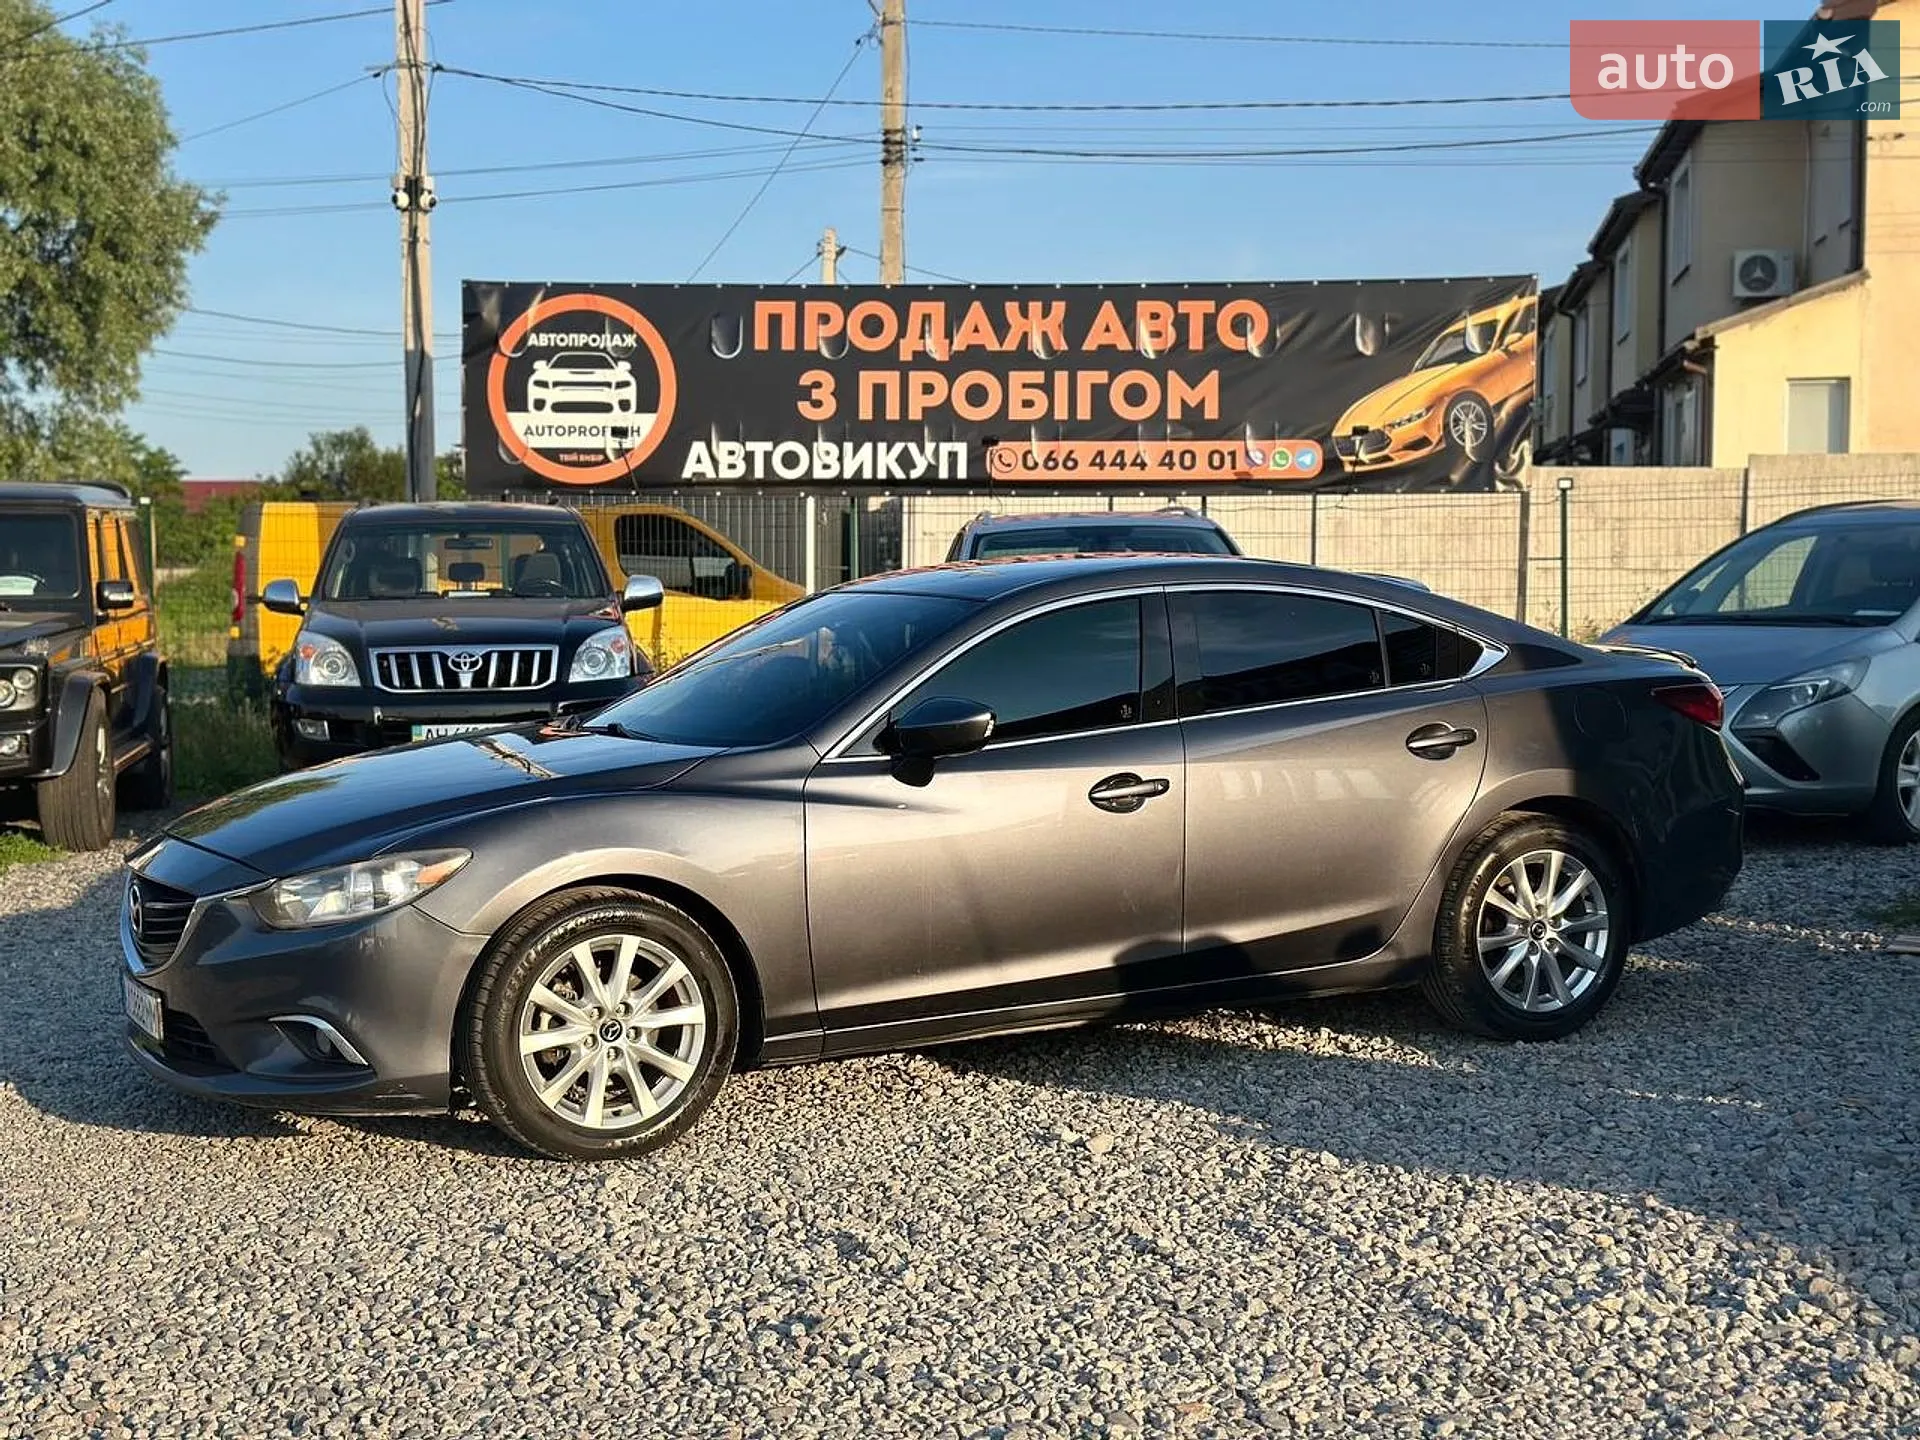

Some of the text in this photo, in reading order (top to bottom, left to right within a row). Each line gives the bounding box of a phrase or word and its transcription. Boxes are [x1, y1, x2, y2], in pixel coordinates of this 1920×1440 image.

[527, 333, 638, 349] АВТОПРОДАЖ
[754, 300, 1269, 361] ПРОДАЖ АВТО
[798, 370, 1219, 421] З ПРОБІГОМ
[524, 425, 640, 438] AUTOPROH
[681, 442, 967, 480] АВТОВИКУП
[1021, 449, 1238, 471] 066 444 40 01
